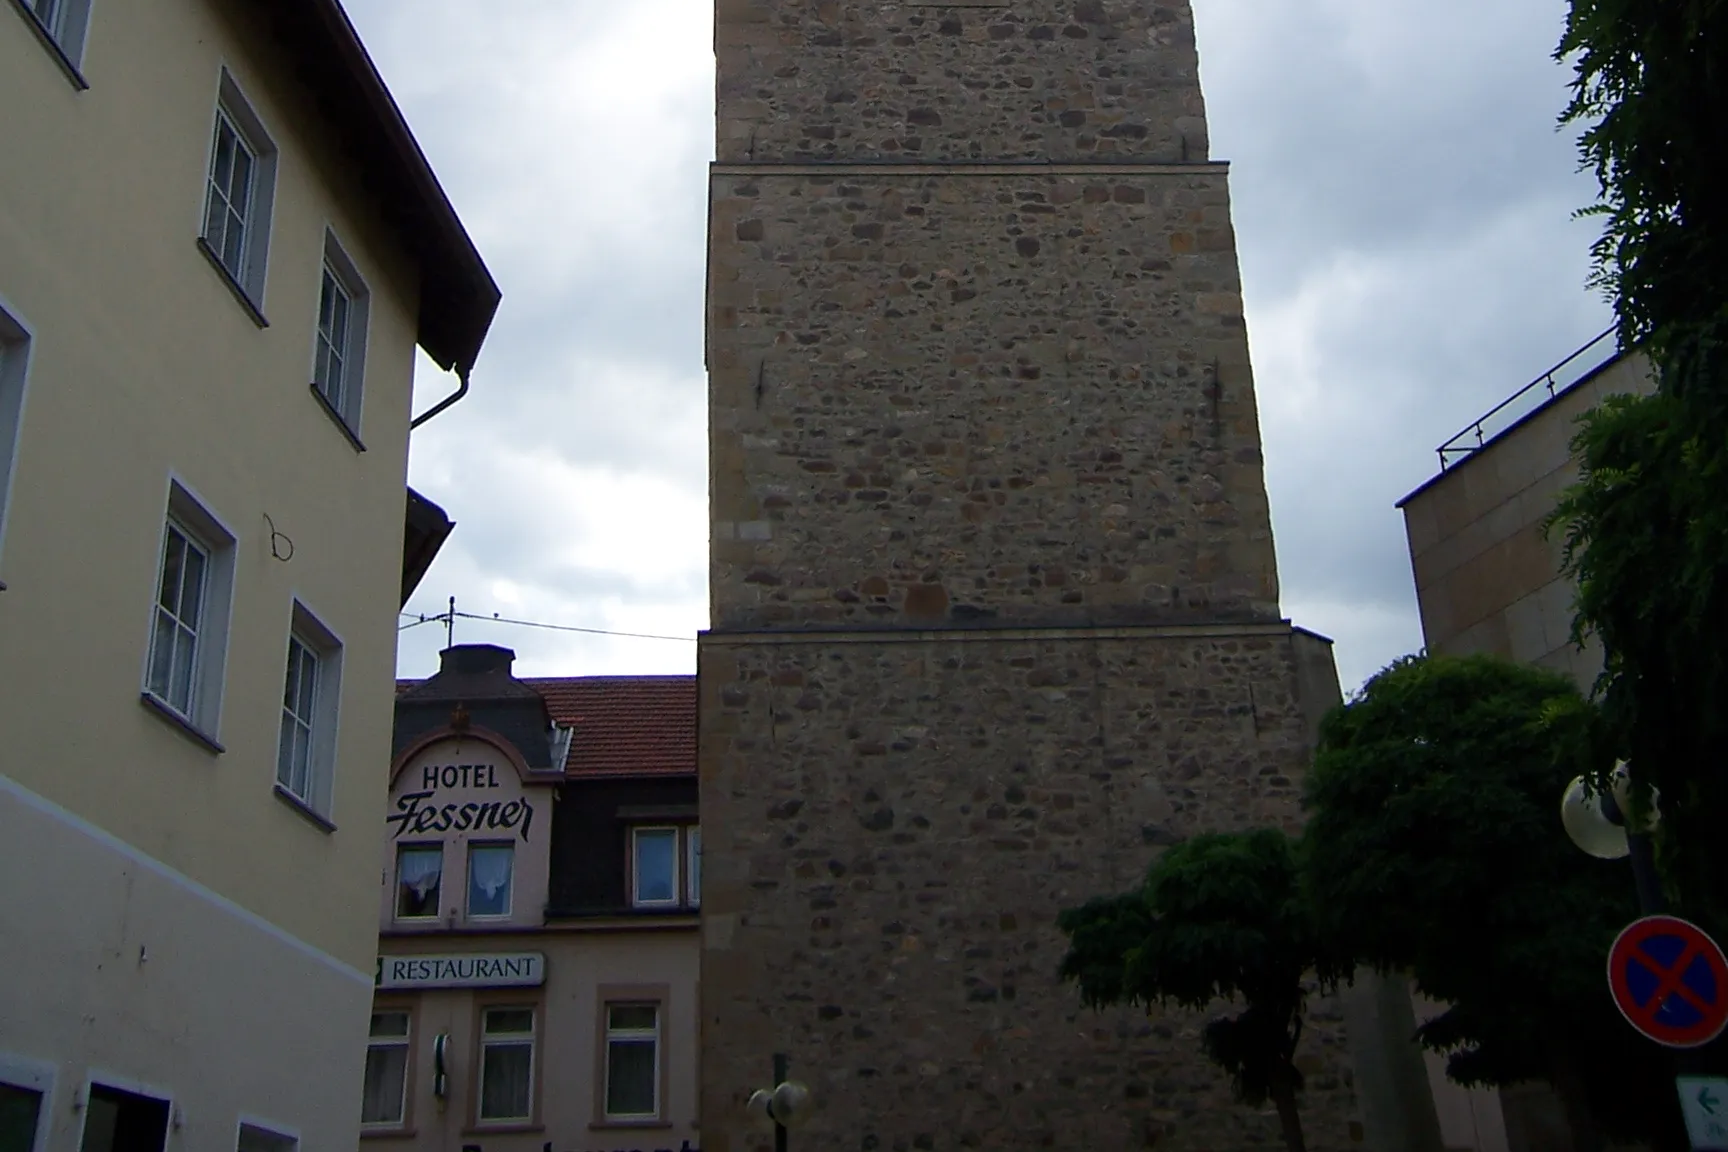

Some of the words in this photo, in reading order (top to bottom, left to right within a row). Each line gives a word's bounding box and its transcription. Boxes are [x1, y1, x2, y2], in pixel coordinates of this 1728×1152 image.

[424, 765, 499, 789] HOTEL
[387, 792, 533, 842] Fessner
[393, 958, 536, 980] RESTAURANT
